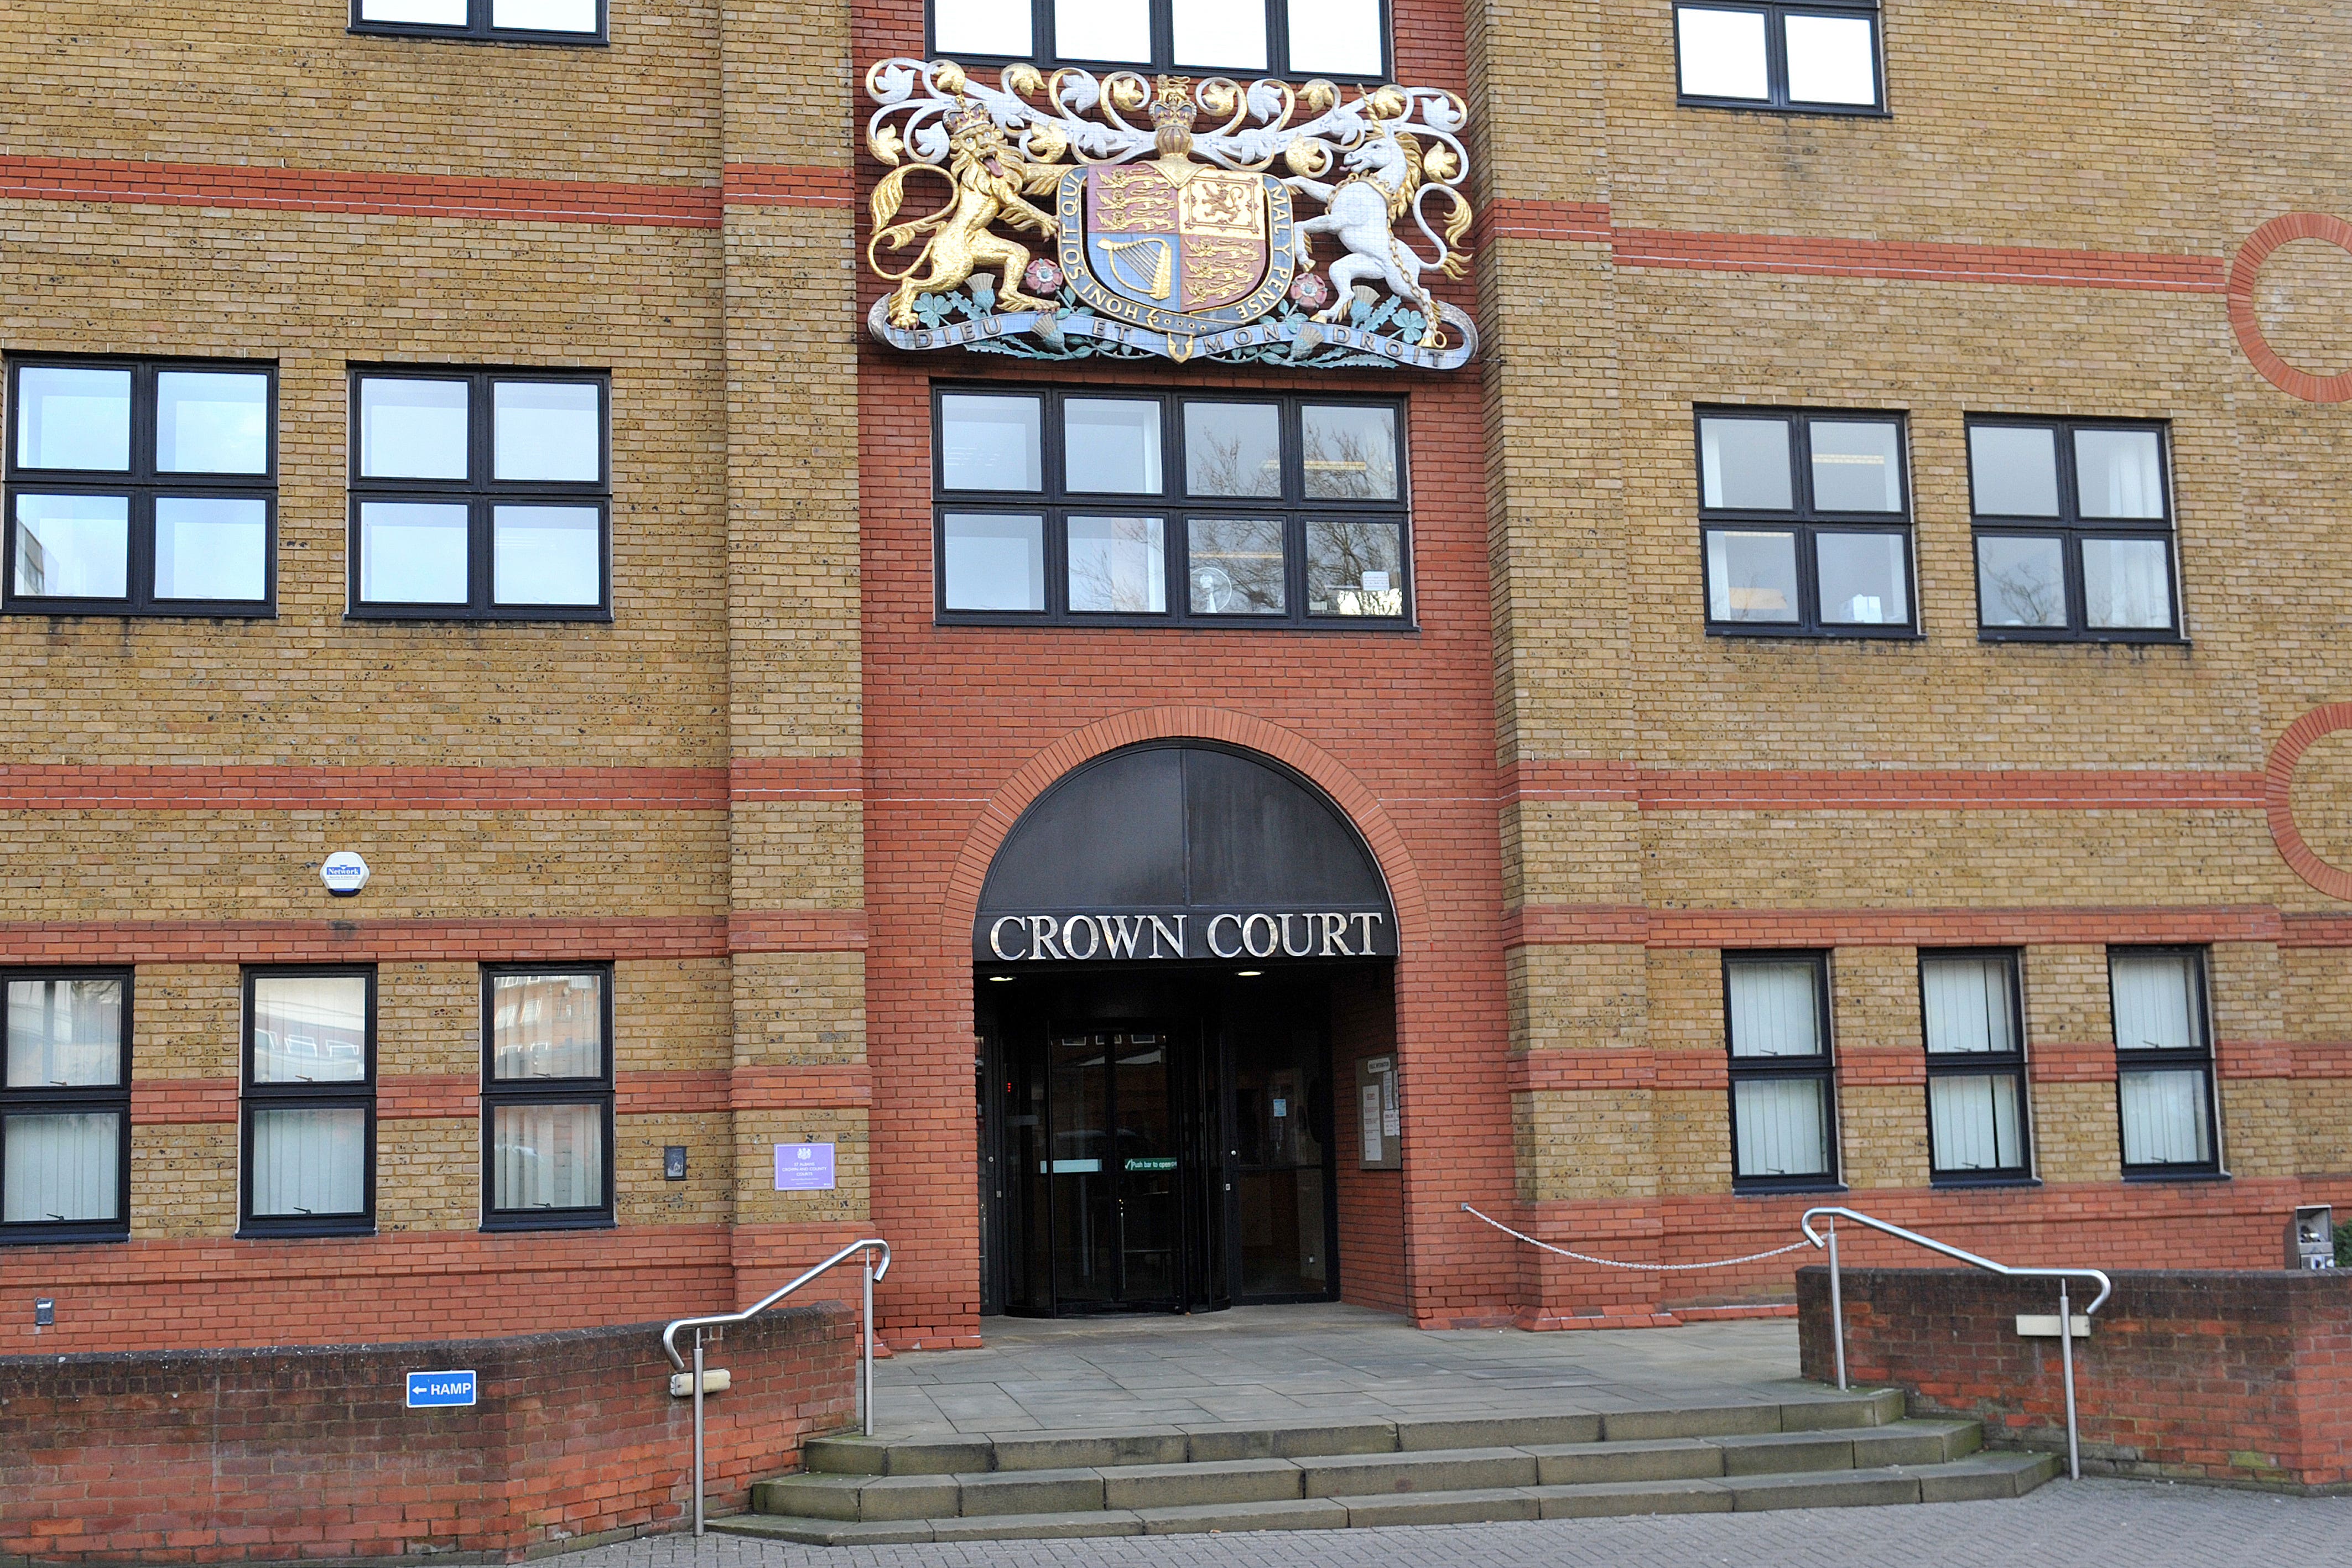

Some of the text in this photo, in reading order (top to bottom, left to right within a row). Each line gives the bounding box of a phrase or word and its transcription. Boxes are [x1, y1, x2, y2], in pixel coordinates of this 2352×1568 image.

[1061, 172, 1291, 320] HONI SOIT QUI MAL Y PENSE
[913, 317, 1446, 367] DIEU ET MON DROIT
[990, 912, 1383, 961] CROWN COURT
[430, 1383, 472, 1395] RAMP
